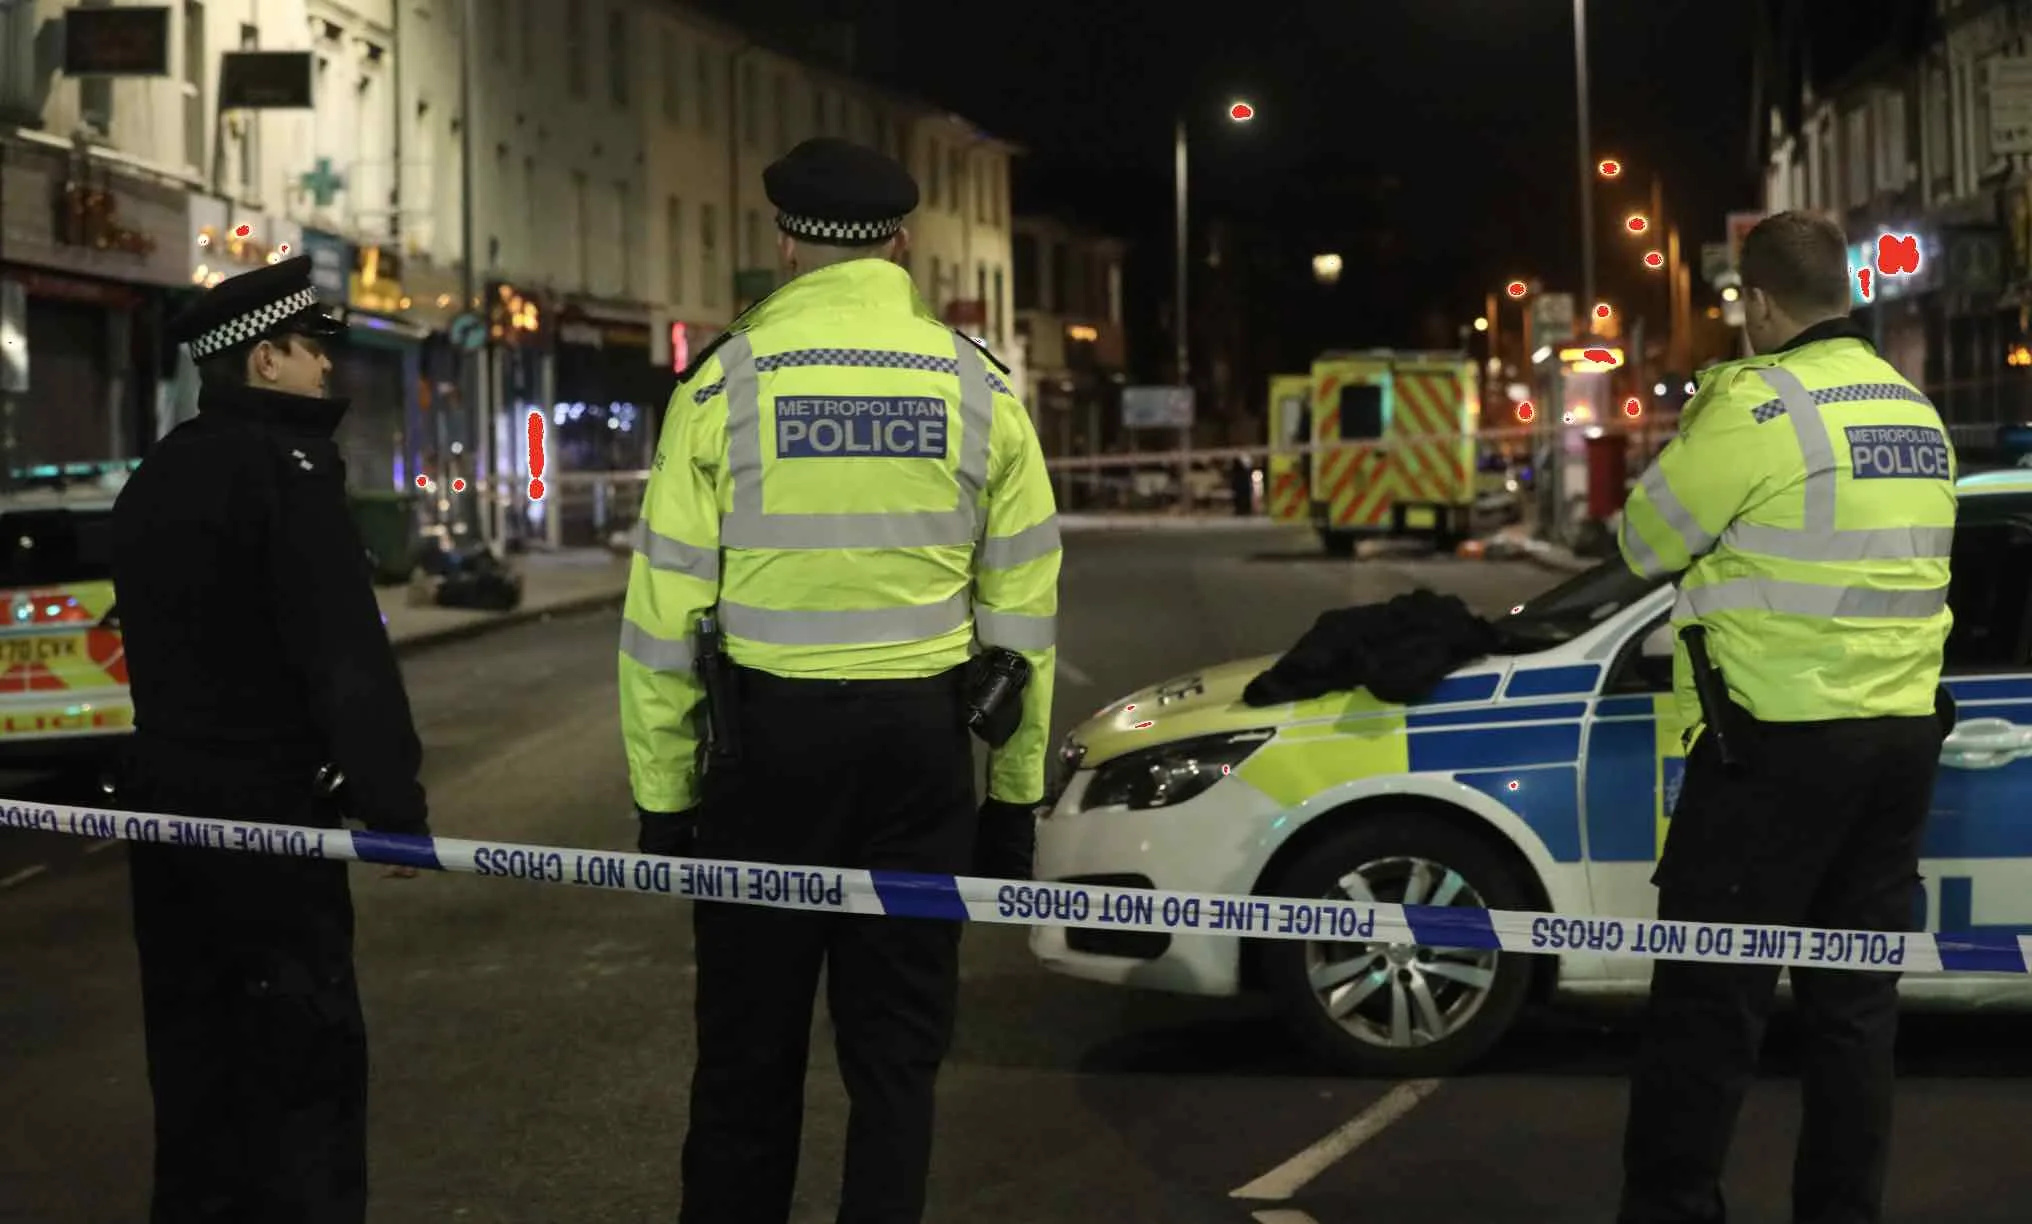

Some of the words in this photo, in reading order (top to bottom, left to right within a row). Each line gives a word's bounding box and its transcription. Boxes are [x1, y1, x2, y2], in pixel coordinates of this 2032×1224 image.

[778, 400, 945, 417] METROPOLITAN
[779, 418, 944, 453] POLICE
[1848, 429, 1943, 443] METROPOLITA
[1853, 445, 1948, 475] POLICE
[473, 847, 563, 882] CROSS
[573, 854, 625, 888] NOT
[634, 859, 671, 892] DO
[680, 863, 739, 899] LINE
[749, 868, 843, 906] POLICE
[998, 884, 1089, 920] CROSS
[1098, 893, 1153, 924] NOT
[1163, 896, 1199, 928] DO
[1210, 900, 1269, 931] LINE
[1279, 904, 1375, 938] POLICE
[1531, 917, 1624, 951] CROSS
[1631, 923, 1686, 954] NOT
[1696, 926, 1733, 956] DO
[1740, 928, 1802, 960] LINE
[1810, 931, 1907, 966] POLICE
